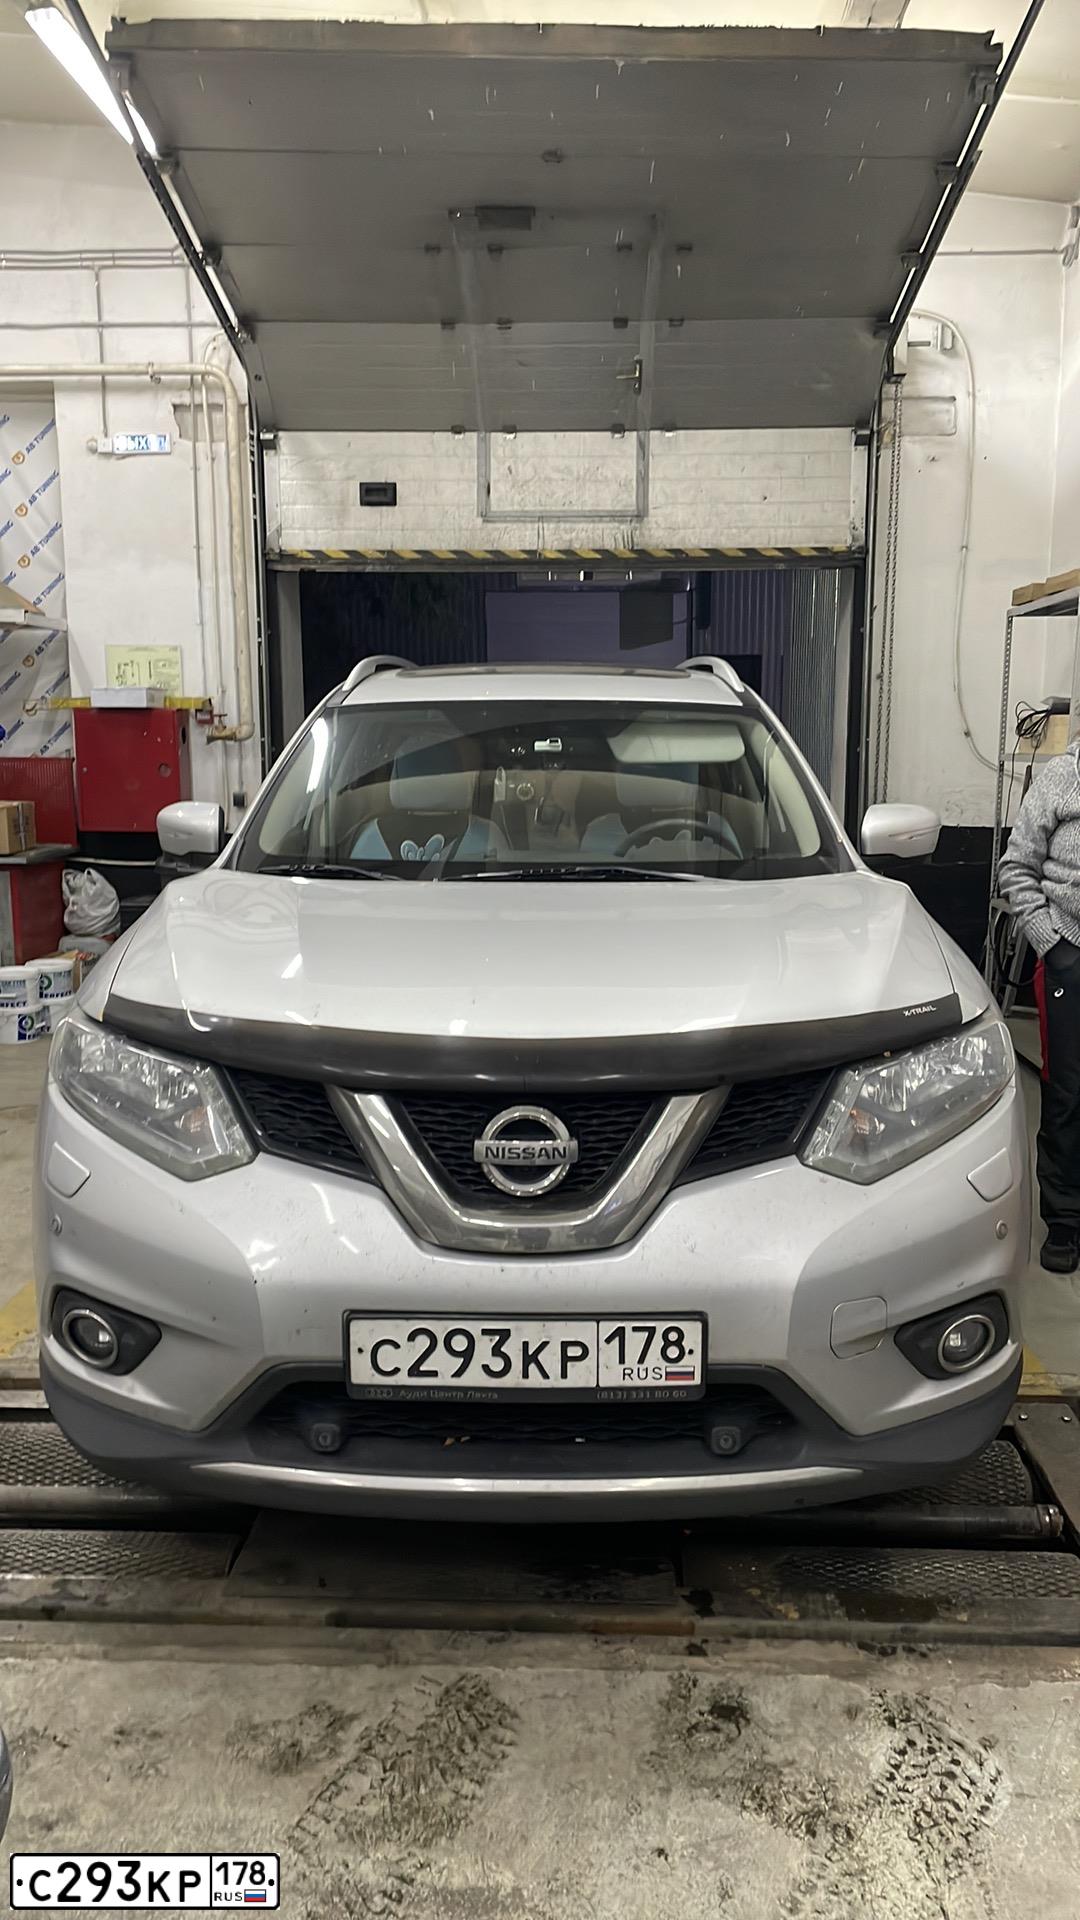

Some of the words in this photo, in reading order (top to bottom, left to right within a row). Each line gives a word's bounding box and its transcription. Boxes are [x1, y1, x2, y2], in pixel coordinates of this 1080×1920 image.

[485, 1146, 567, 1160] NISSAN
[604, 1326, 686, 1365] 178
[622, 1367, 663, 1382] RUS
